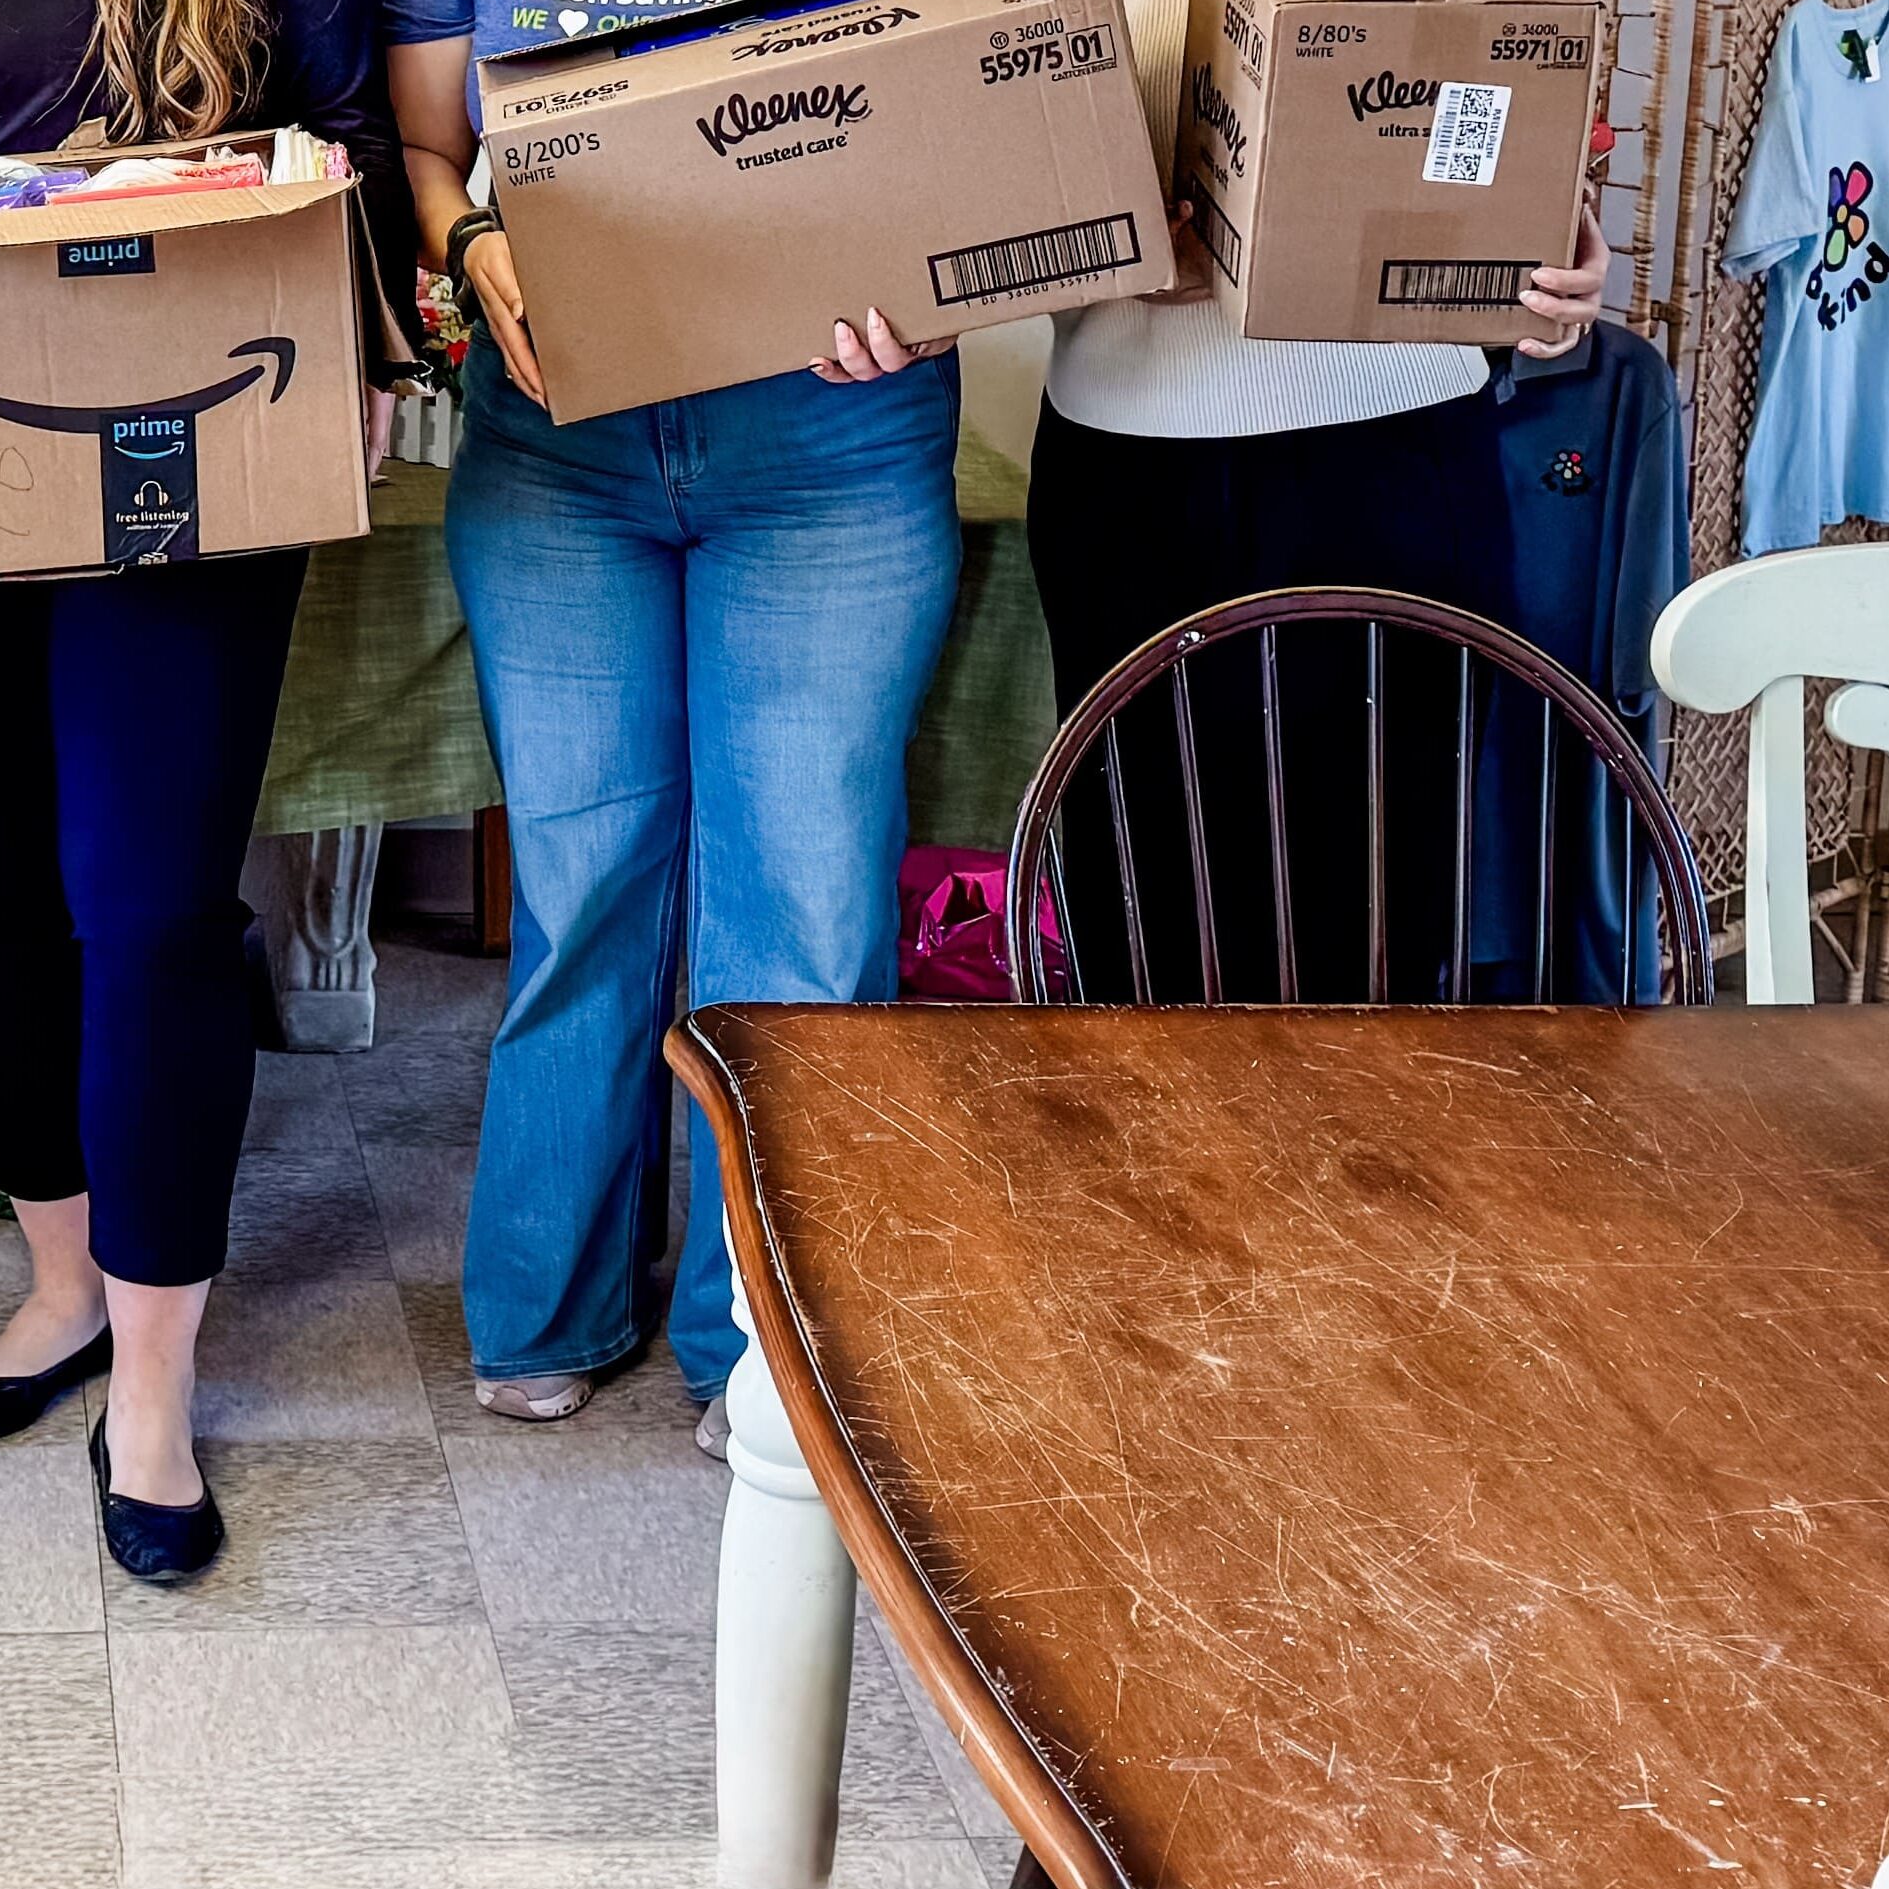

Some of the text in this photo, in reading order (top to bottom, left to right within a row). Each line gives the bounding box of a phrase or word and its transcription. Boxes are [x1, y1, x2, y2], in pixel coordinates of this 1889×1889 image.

[511, 7, 550, 30] WE
[1014, 17, 1065, 43] 36000
[1223, 0, 1250, 57] 55971
[731, 7, 921, 61] Kleenex
[1297, 24, 1367, 46] 8/80's
[979, 30, 1103, 85] 55975 01
[1295, 46, 1335, 58] WHITE
[1490, 38, 1584, 61] 55971 01
[515, 79, 629, 115] 55975 01
[695, 84, 870, 157] Kleenex
[1191, 60, 1247, 174] Kleenex
[1378, 122, 1419, 138] ultra
[504, 132, 600, 170] 8/200's
[736, 133, 848, 171] trusted care
[508, 166, 556, 187] WHITE
[68, 237, 140, 267] prime
[113, 415, 185, 444] prime
[115, 510, 190, 523] free listening
